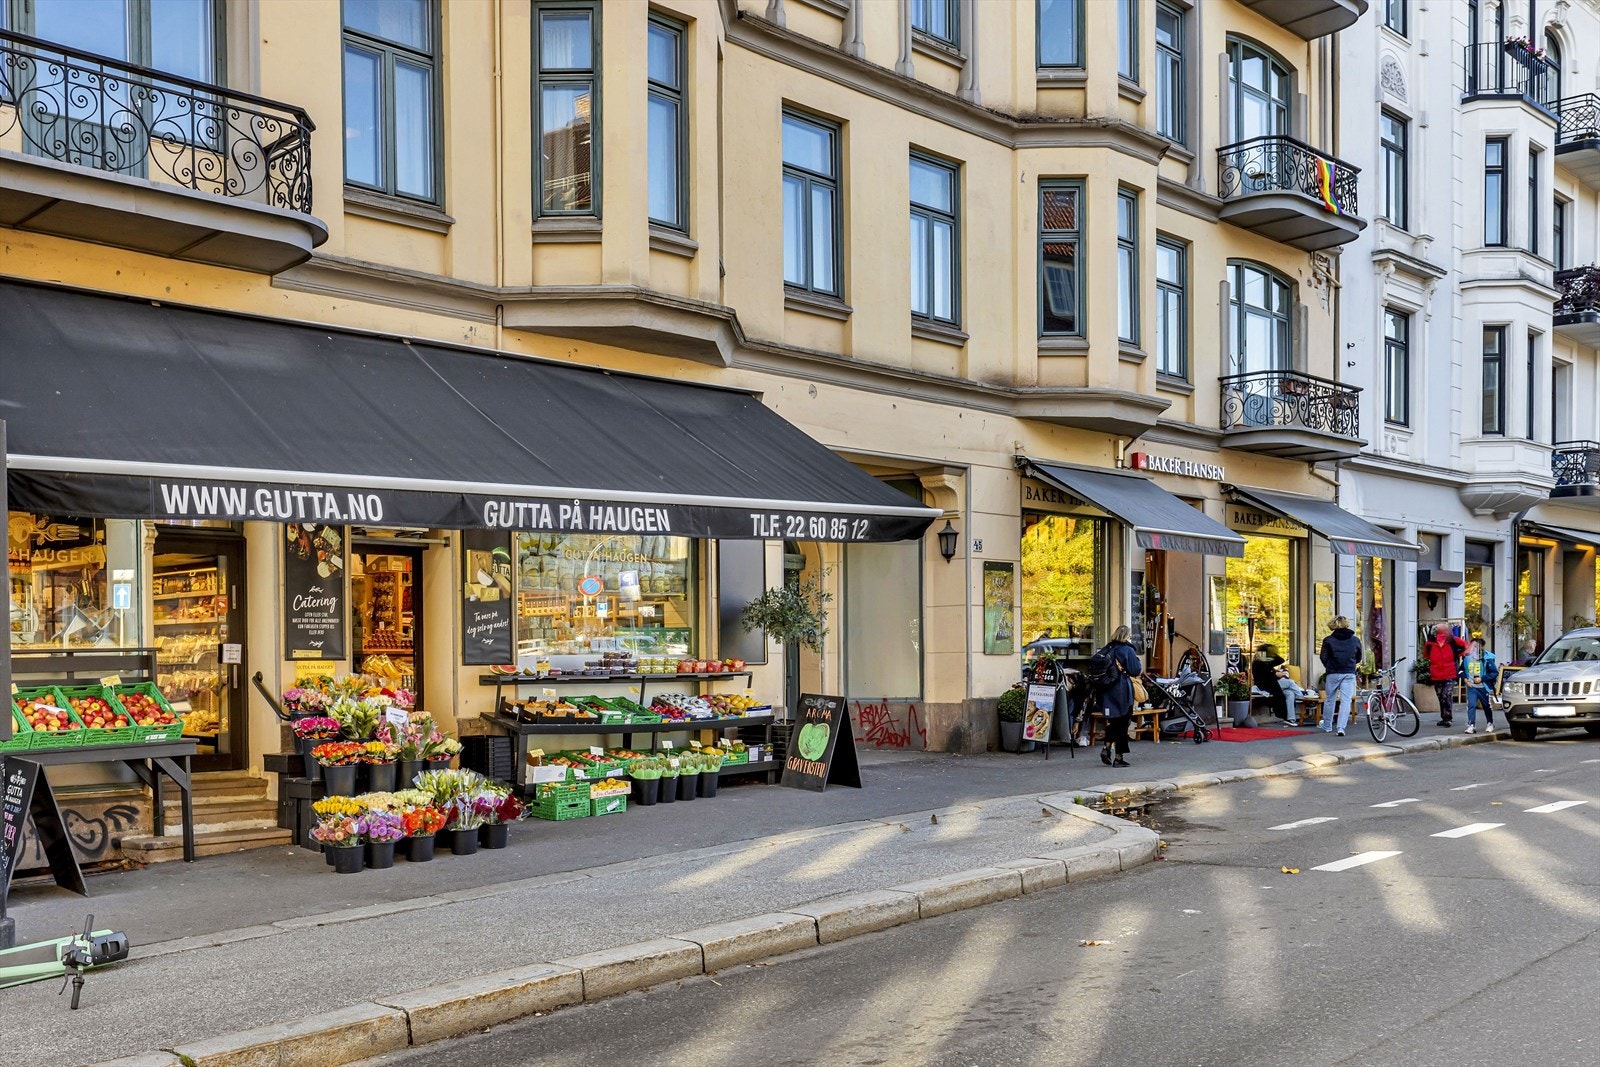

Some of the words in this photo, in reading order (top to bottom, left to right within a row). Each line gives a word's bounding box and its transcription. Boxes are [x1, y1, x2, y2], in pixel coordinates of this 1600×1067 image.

[1148, 454, 1182, 474] BAKER
[1184, 460, 1225, 481] HANSEN
[160, 483, 384, 522] WWW.GUTTA.NO
[1025, 485, 1066, 505] BAKER
[484, 500, 553, 529] GUTTA
[559, 498, 584, 530] PÅ
[589, 505, 671, 532] HAUGEN
[1234, 511, 1264, 527] BAKER
[750, 513, 781, 537] TLF.
[786, 515, 805, 538] 22
[809, 516, 827, 539] 60
[830, 517, 848, 540] 85
[851, 518, 869, 540] 12
[973, 540, 983, 551] 45
[1193, 538, 1231, 556] HANSEN
[19, 548, 92, 563] HAUGEN
[565, 549, 599, 561] GUTTA
[606, 550, 648, 563] HAUGEN
[293, 594, 338, 613] Catering
[473, 611, 481, 623] Ta
[466, 625, 477, 638] deg
[805, 708, 832, 721] AROMA
[7, 785, 23, 797] GUTTA
